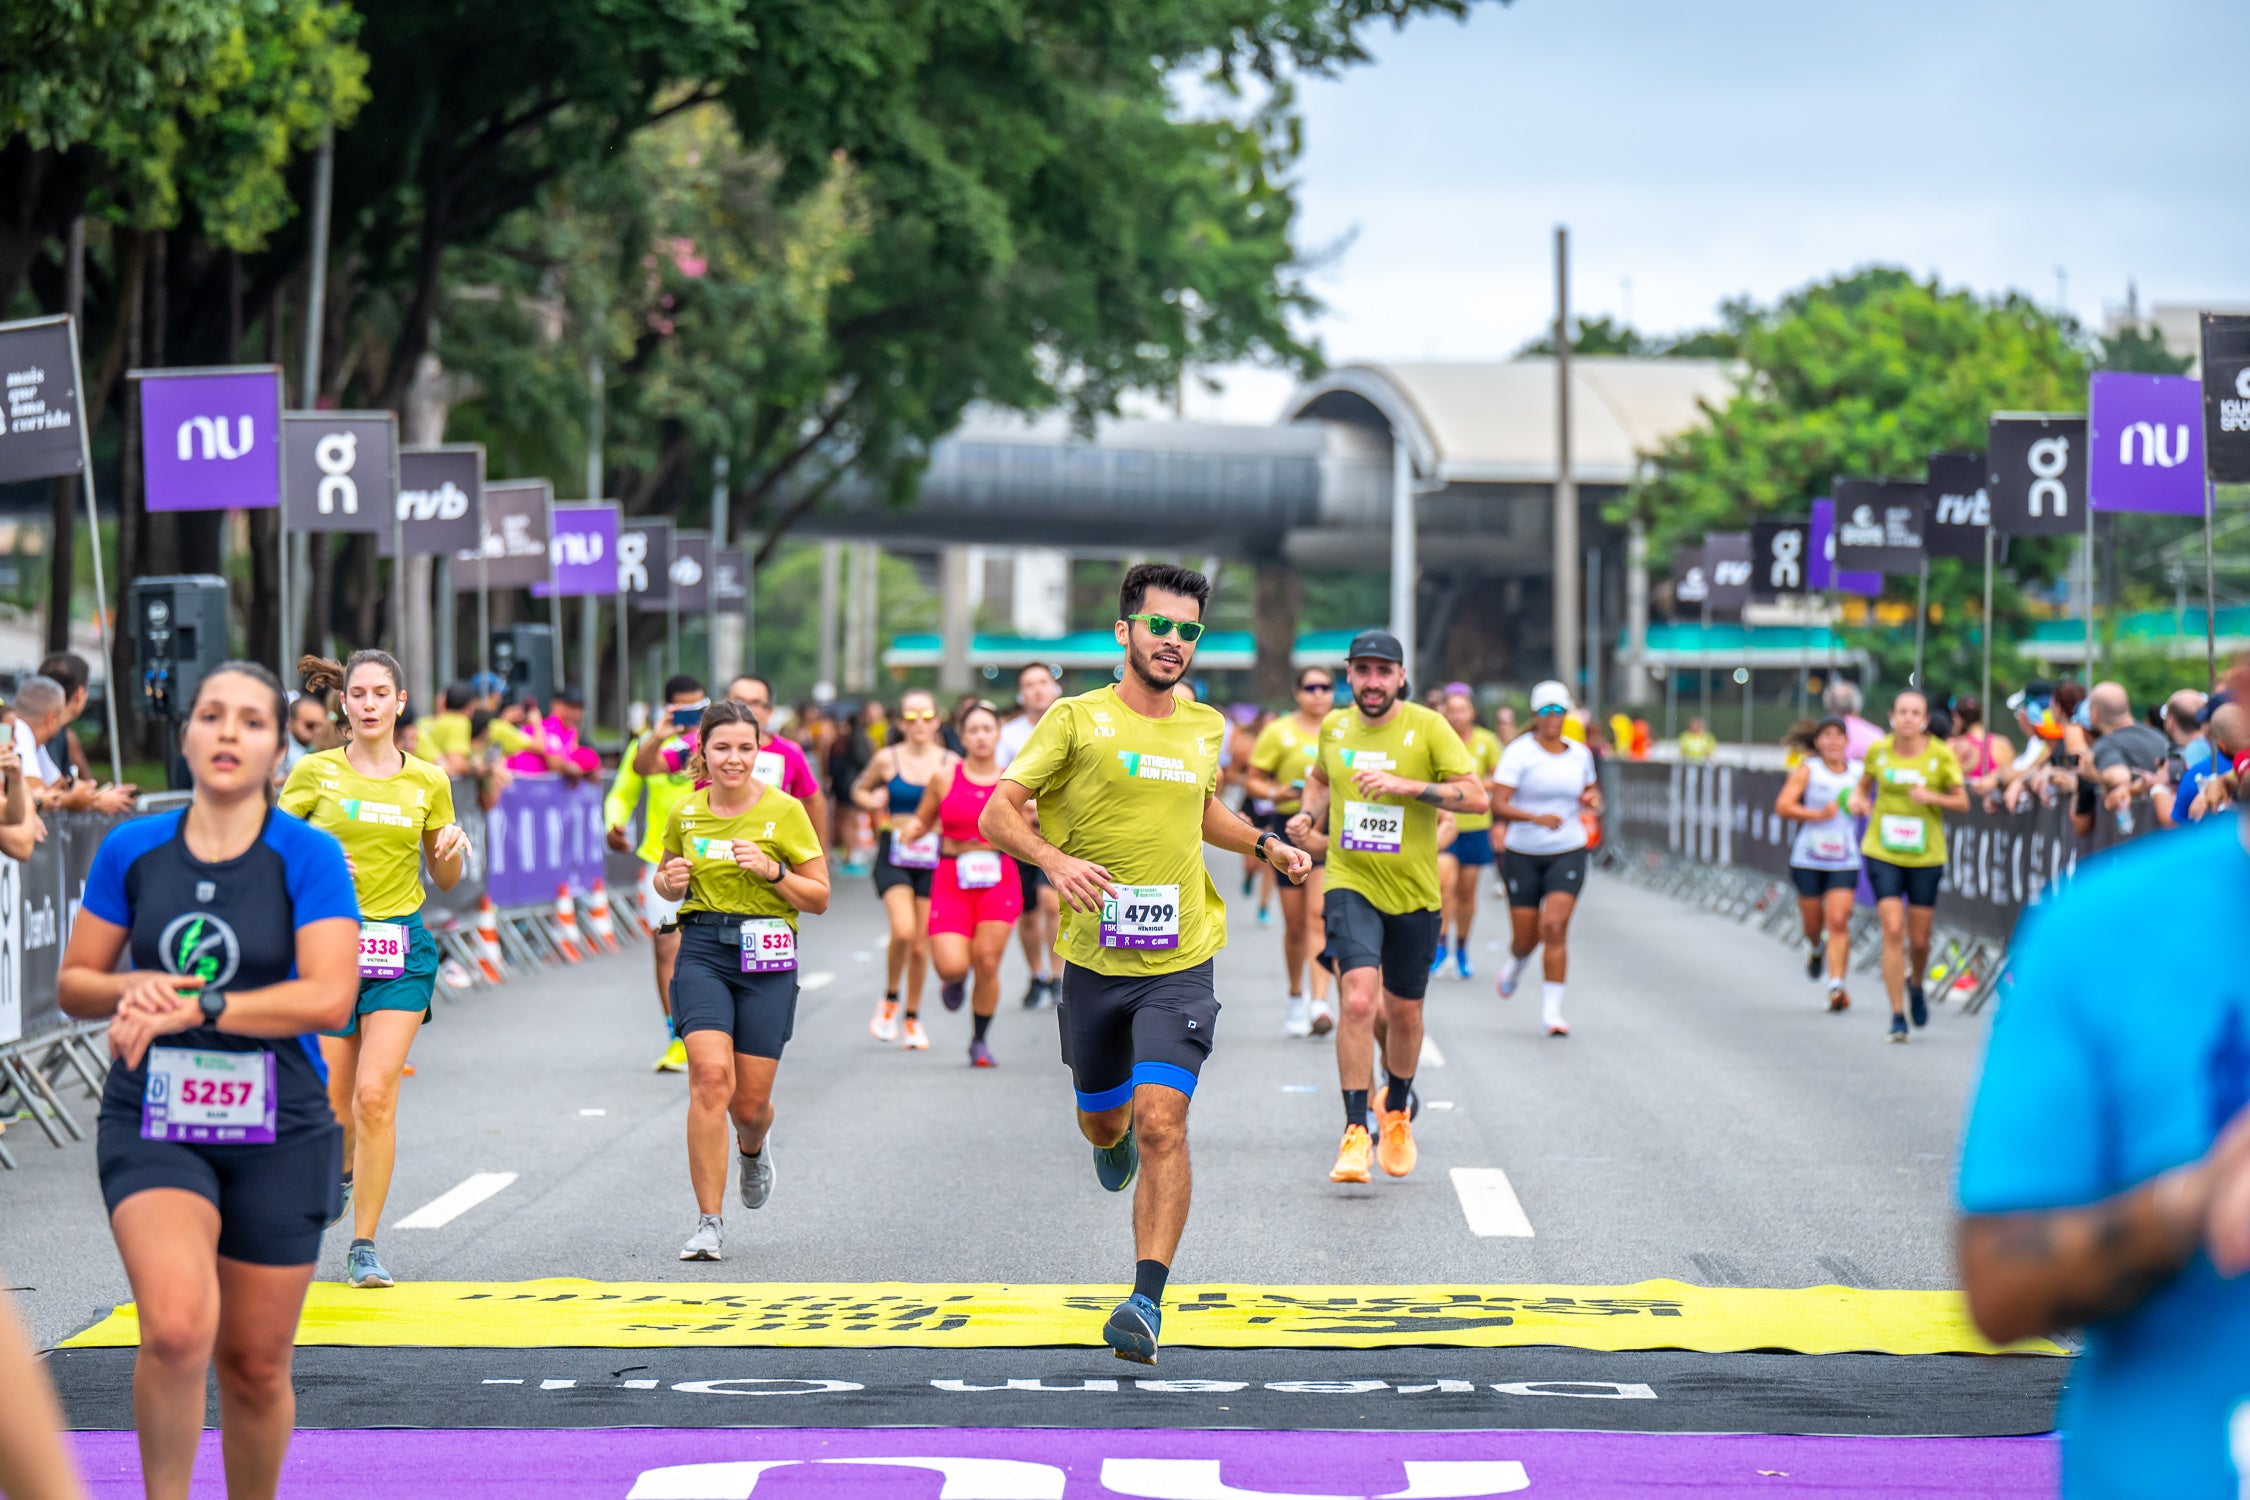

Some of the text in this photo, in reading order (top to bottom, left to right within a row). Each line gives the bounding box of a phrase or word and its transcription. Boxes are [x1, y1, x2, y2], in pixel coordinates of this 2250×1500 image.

[1139, 753, 1185, 771] ATHENAS
[1139, 766, 1197, 785] RUN FASTER
[1360, 817, 1398, 833] 4982
[1125, 904, 1174, 923] 4799
[358, 938, 399, 956] 5338
[181, 1078, 254, 1107] 5257
